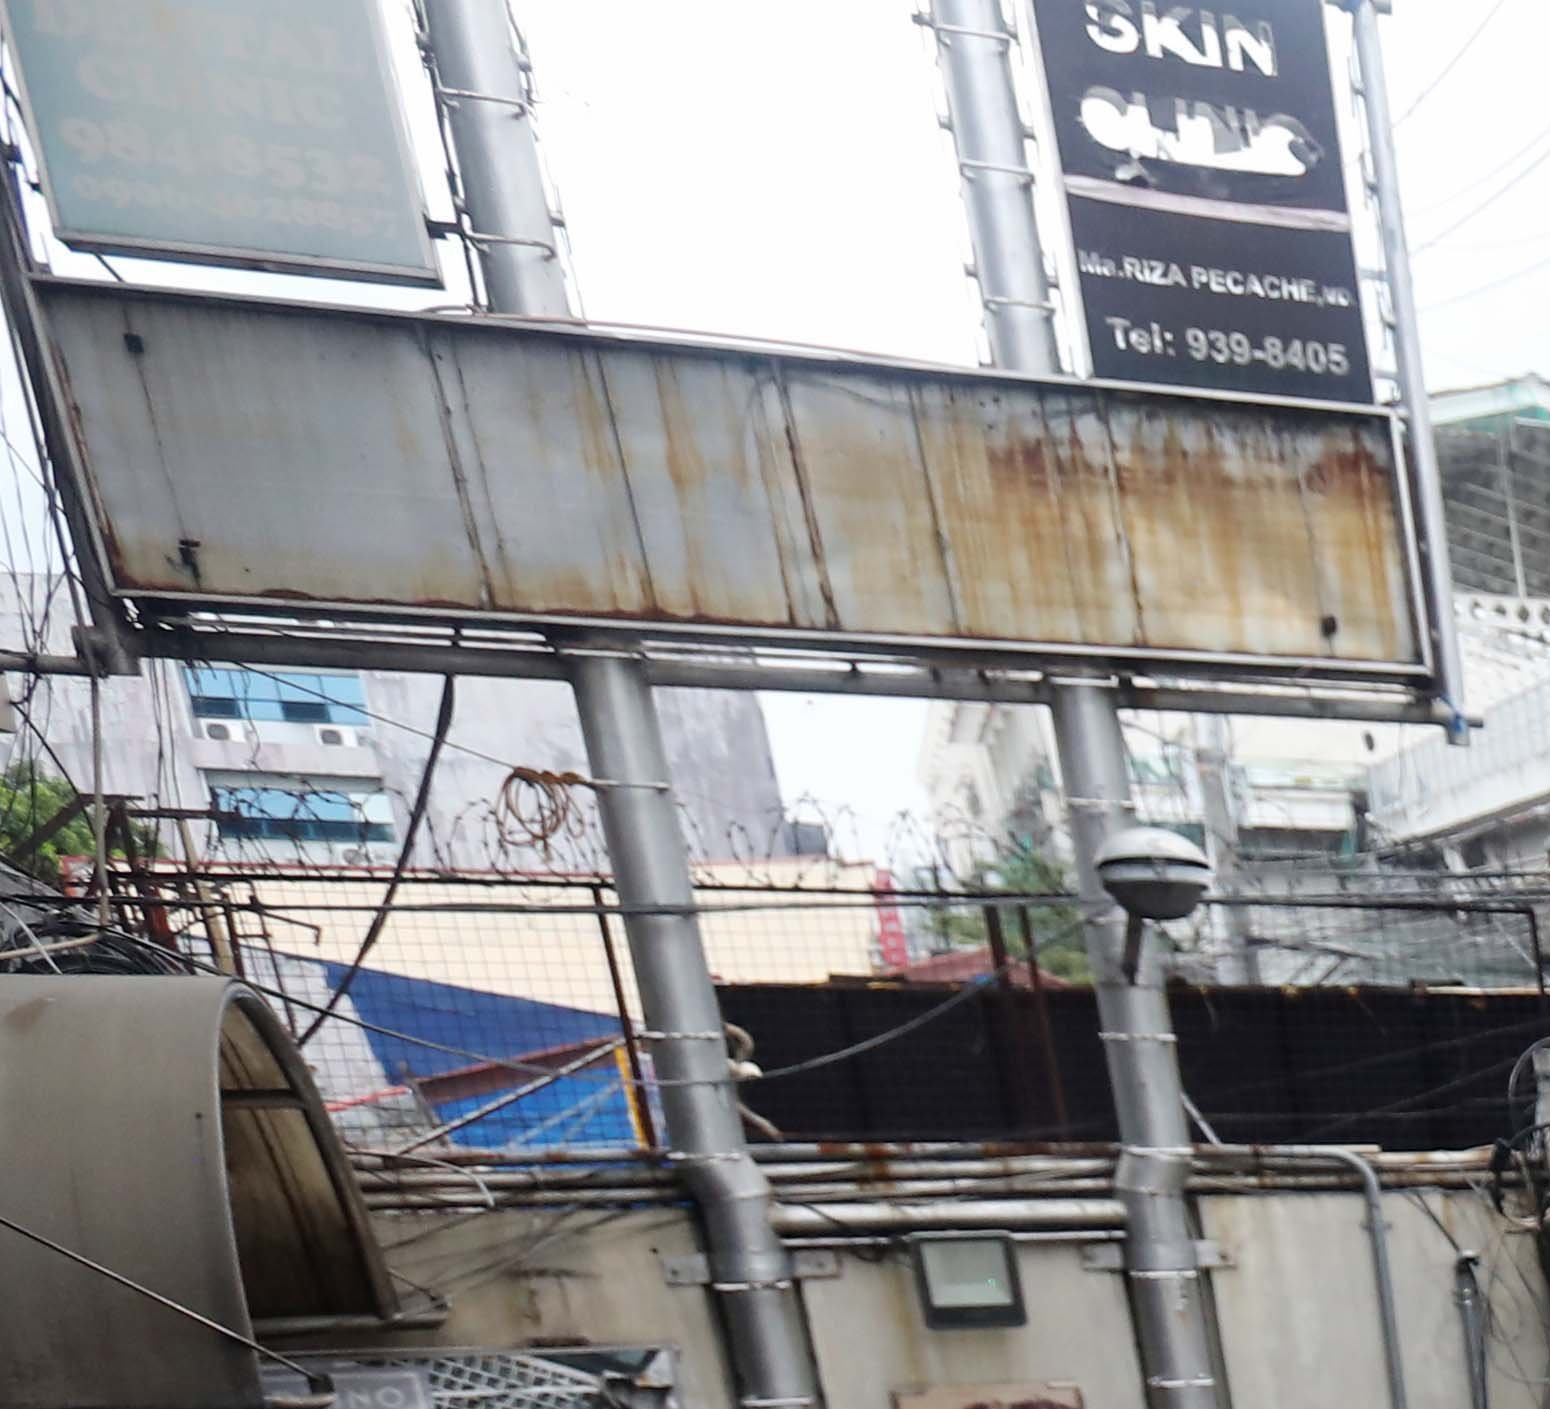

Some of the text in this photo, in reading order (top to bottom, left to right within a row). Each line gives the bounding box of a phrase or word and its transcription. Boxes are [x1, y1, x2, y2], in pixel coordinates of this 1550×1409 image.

[1085, 0, 1277, 76] SKIN
[1106, 316, 1350, 376] Tel: 939-8405
